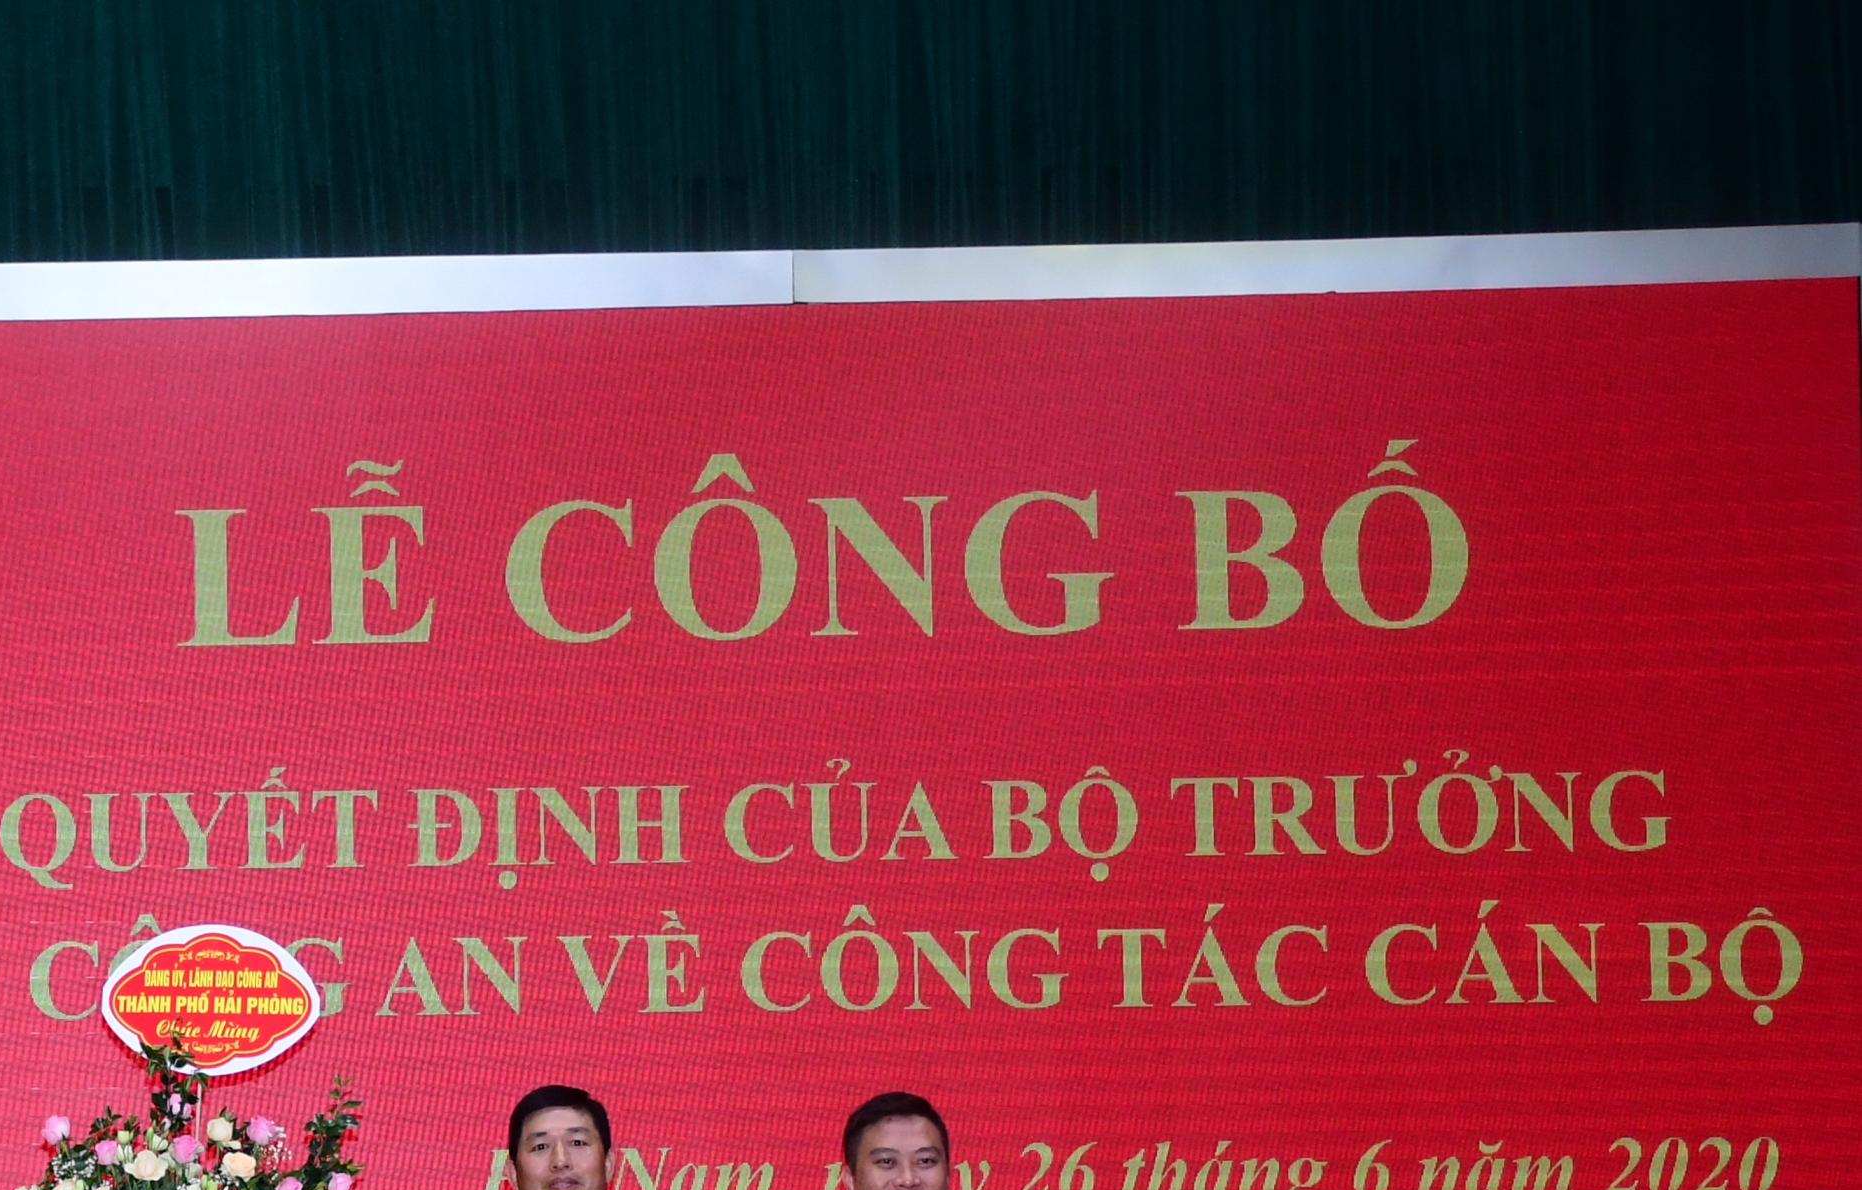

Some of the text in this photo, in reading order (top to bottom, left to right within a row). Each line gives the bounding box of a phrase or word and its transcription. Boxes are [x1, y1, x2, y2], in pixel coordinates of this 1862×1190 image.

[175, 439, 1469, 646] LỄ CÔNG BỐ
[0, 749, 1671, 889] QUYẾT ĐỊNH CỦA BỘ TRƯỞNG
[30, 914, 350, 1020] CG
[376, 935, 522, 1015] AN
[559, 910, 704, 1013] VỀ
[741, 904, 1069, 1011] CÔNG
[1098, 903, 1328, 1007] TÁC
[1363, 899, 1598, 1004] CÁN
[1640, 906, 1803, 1025] BỘ
[144, 963, 170, 988] ĐẢNG
[188, 967, 213, 989] LÃNH
[215, 970, 234, 992] ĐẠO
[236, 967, 263, 989] CÔNG
[264, 970, 278, 989] AN
[117, 990, 304, 1016] THÀNH PHỐ HẢI PHÒNG
[203, 1019, 260, 1043] Mừng
